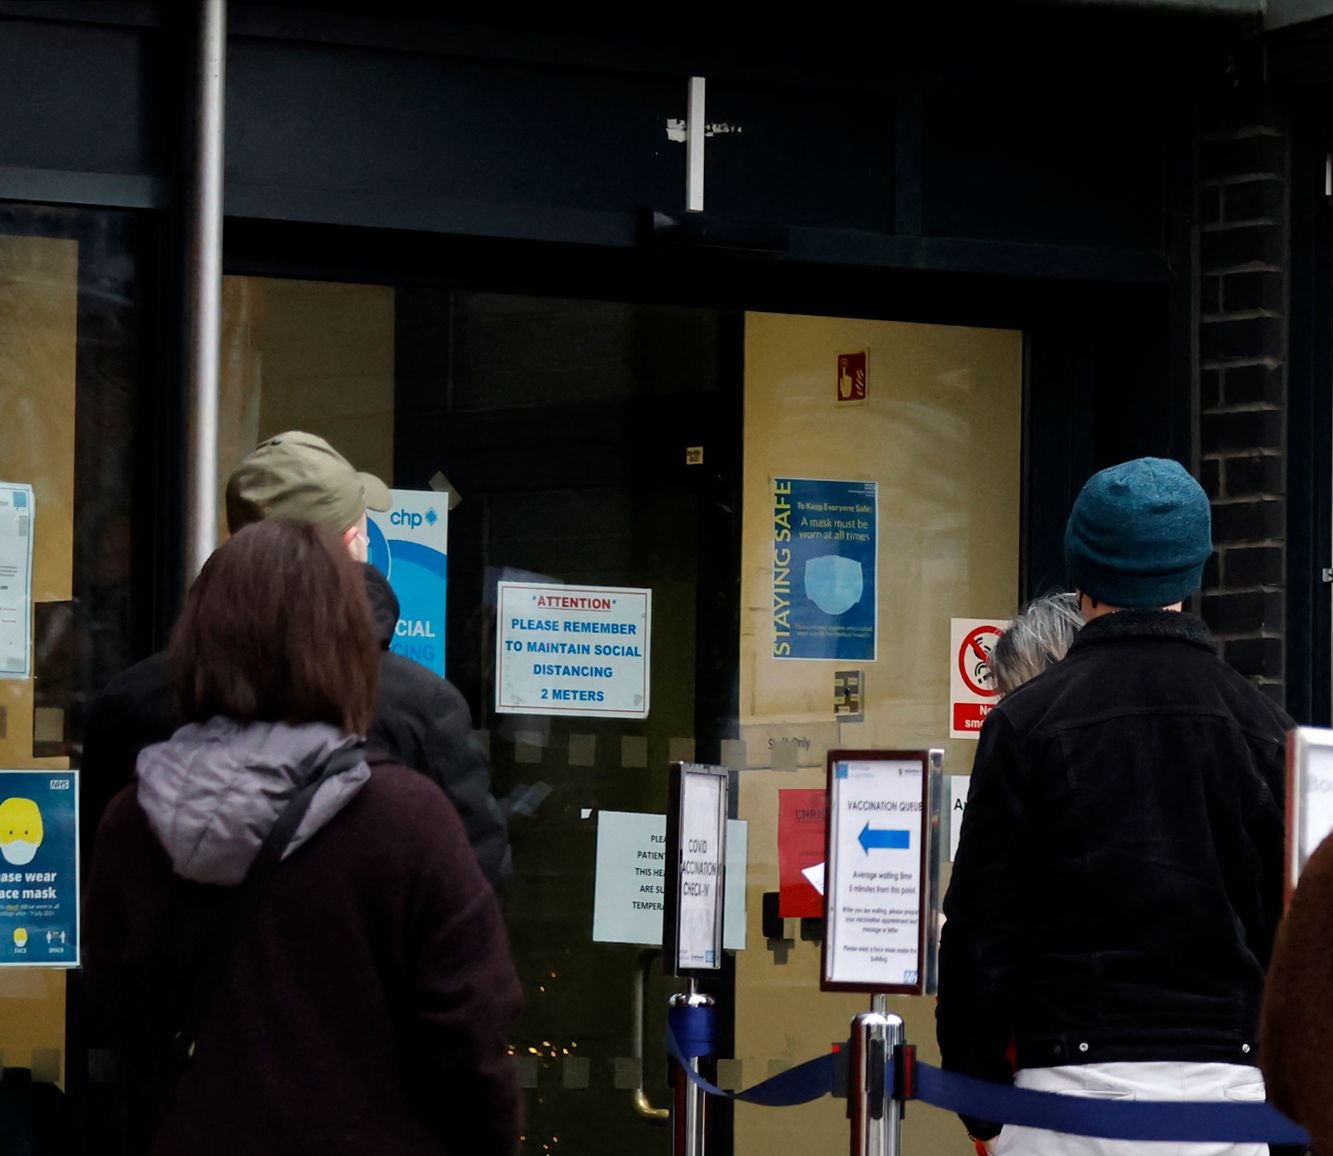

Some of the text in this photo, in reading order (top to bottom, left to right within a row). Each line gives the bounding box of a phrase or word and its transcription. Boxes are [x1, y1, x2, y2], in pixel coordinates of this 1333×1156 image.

[390, 509, 422, 530] chp
[800, 516, 869, 529] A mask must be
[799, 530, 871, 542] worn at all times
[774, 481, 792, 656] STAYING SAFE
[395, 619, 436, 638] CIAL
[511, 618, 637, 635] PLEASE REMEMBER
[393, 643, 435, 661] CING
[505, 640, 642, 658] TO MAINTAIN SOCIAL
[533, 663, 613, 678] DISTANCING
[540, 688, 605, 702] 2 METERS
[51, 780, 69, 789] NHS
[847, 800, 923, 812] VACCINATION QUEUE
[651, 835, 667, 844] PLE
[688, 838, 708, 854] COVID
[637, 850, 666, 861] PATIEN
[635, 868, 667, 878] THIS HE
[681, 860, 717, 876] ACCINATION
[0, 872, 57, 882] ase wear
[0, 886, 57, 899] ace mask
[639, 884, 654, 894] ARE
[632, 901, 665, 911] TEMPER
